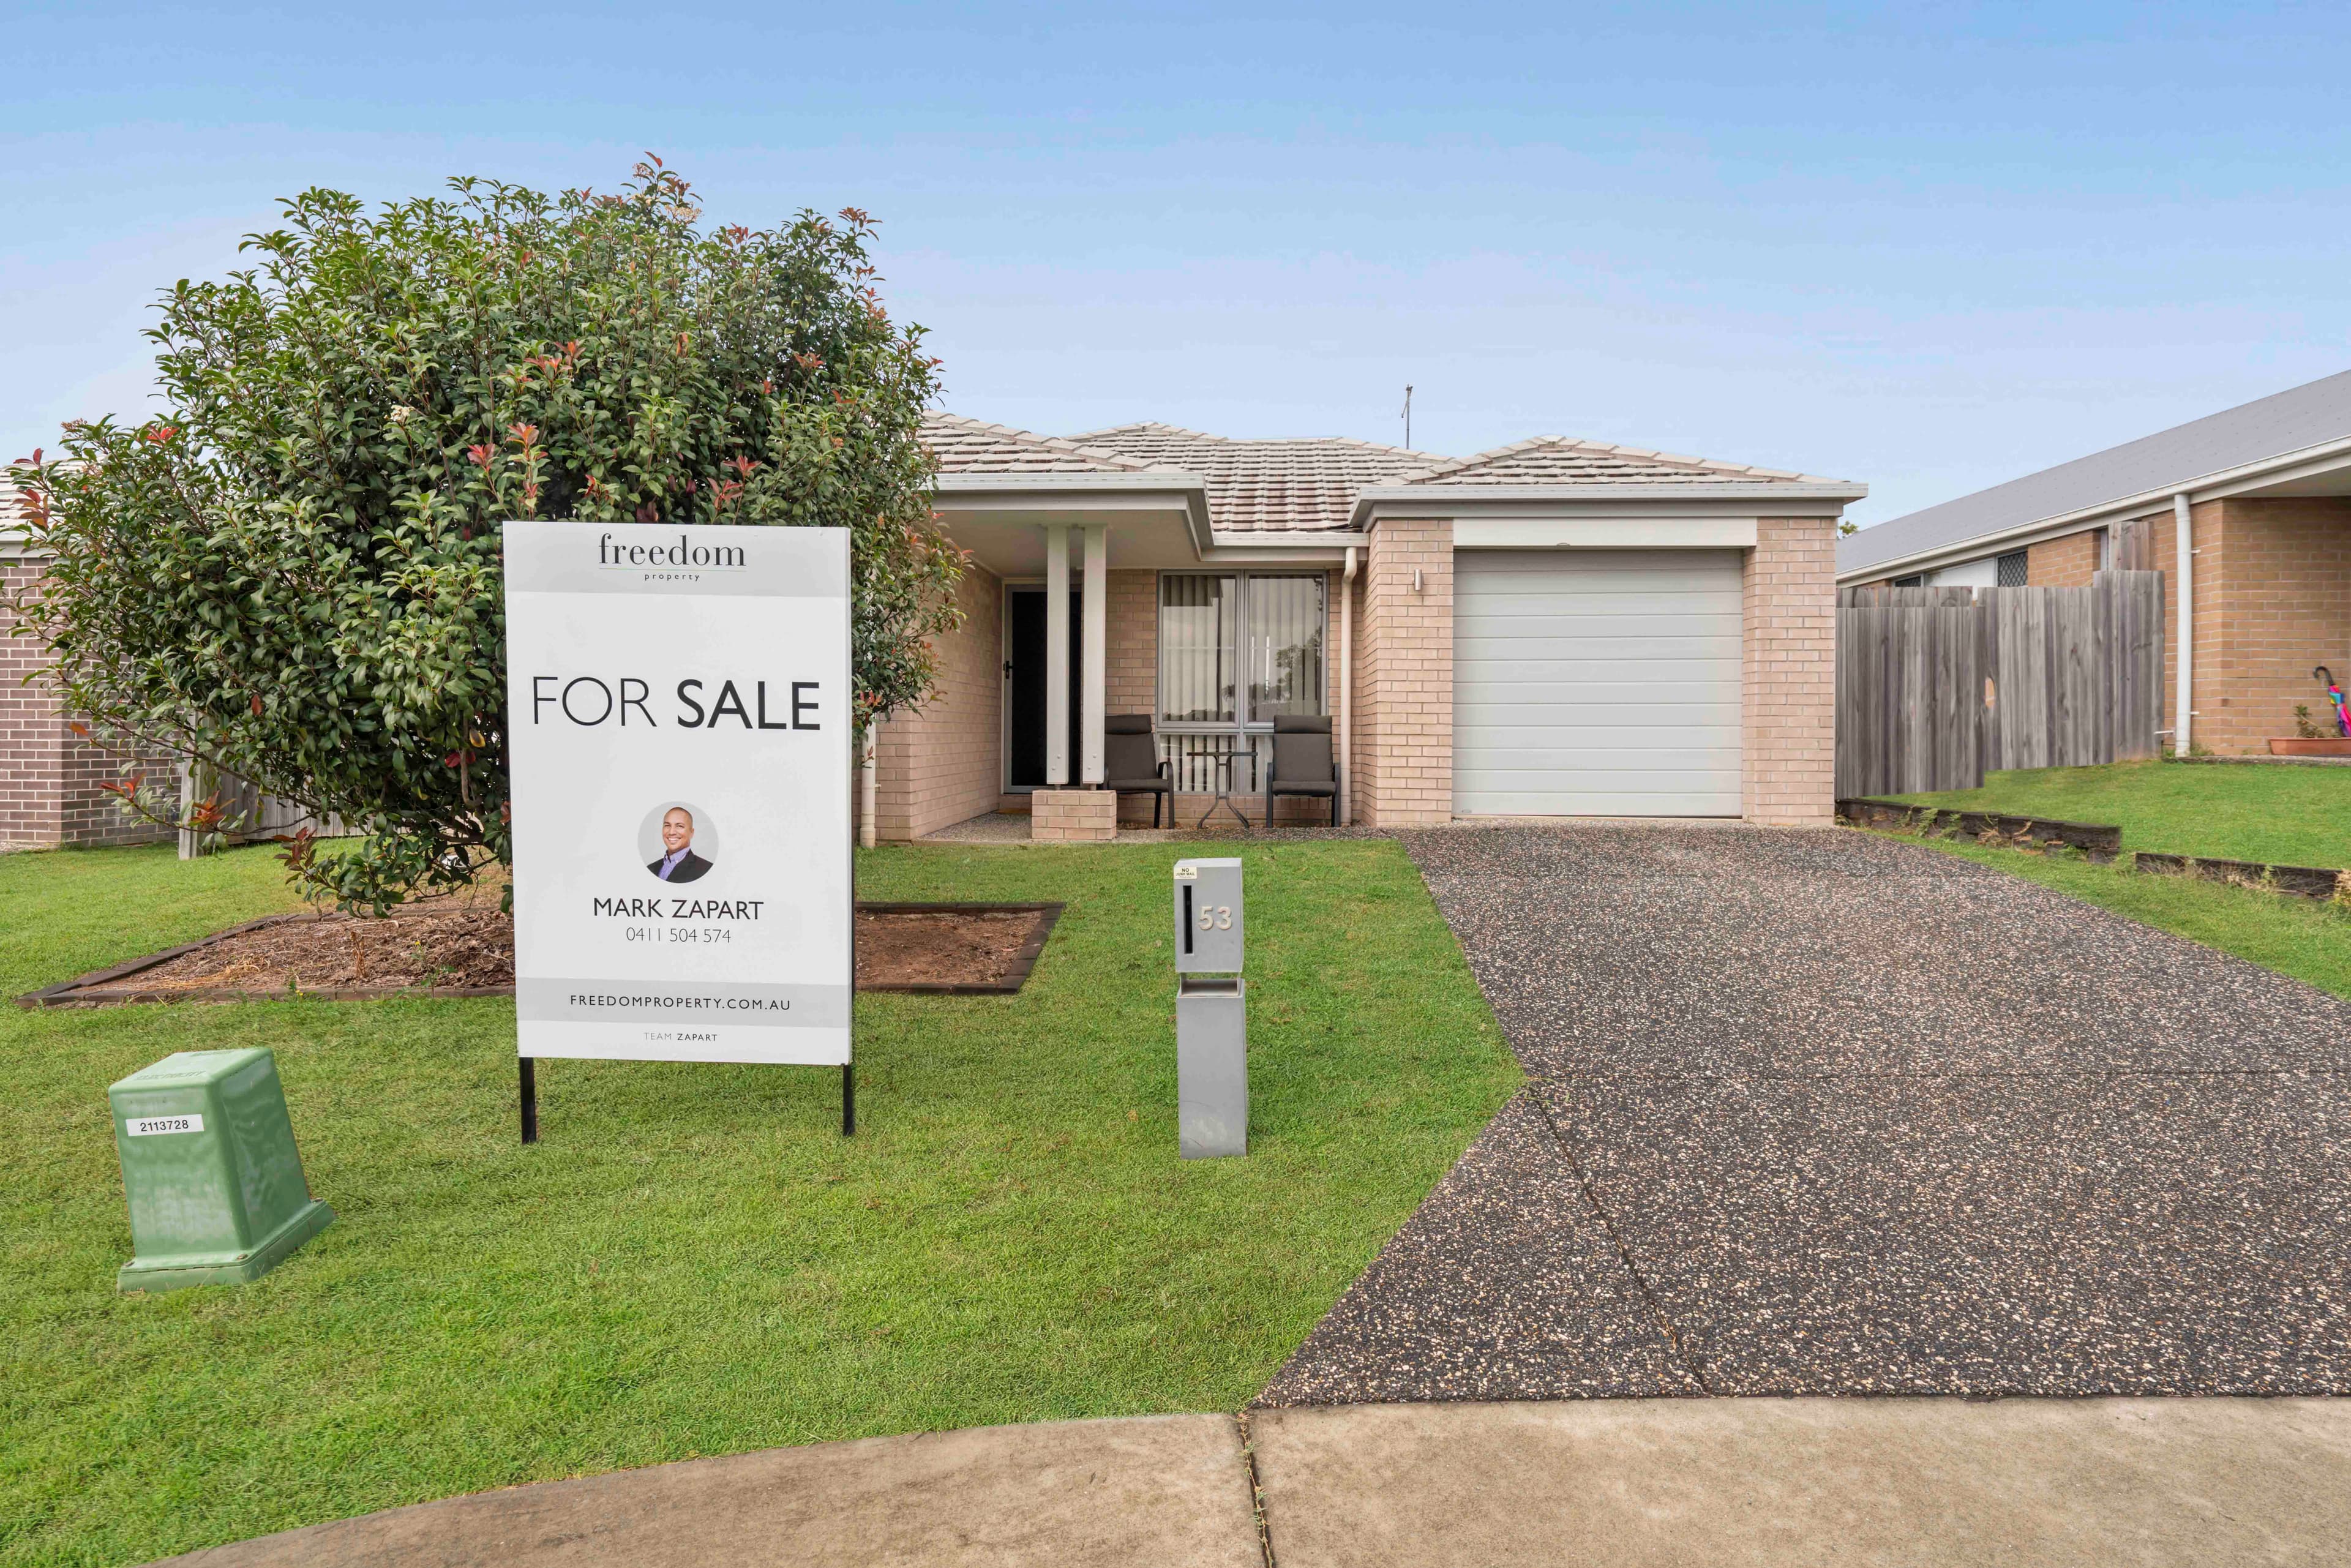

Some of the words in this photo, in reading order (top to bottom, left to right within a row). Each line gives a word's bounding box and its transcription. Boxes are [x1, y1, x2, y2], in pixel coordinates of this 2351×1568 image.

[598, 533, 746, 566] freedom
[533, 676, 657, 727] FOR
[677, 679, 820, 730] SALE
[593, 898, 664, 918] MARK
[671, 899, 764, 920] ZAPART
[1198, 906, 1232, 931] 53
[626, 927, 661, 942] 0411
[669, 928, 697, 942] 504
[703, 929, 732, 943] 574
[570, 995, 790, 1010] FREEDOMPROPERTY.COM.AU
[643, 1032, 672, 1041] TEAM
[677, 1033, 718, 1041] ZAPART
[140, 1120, 189, 1132] 2113728
